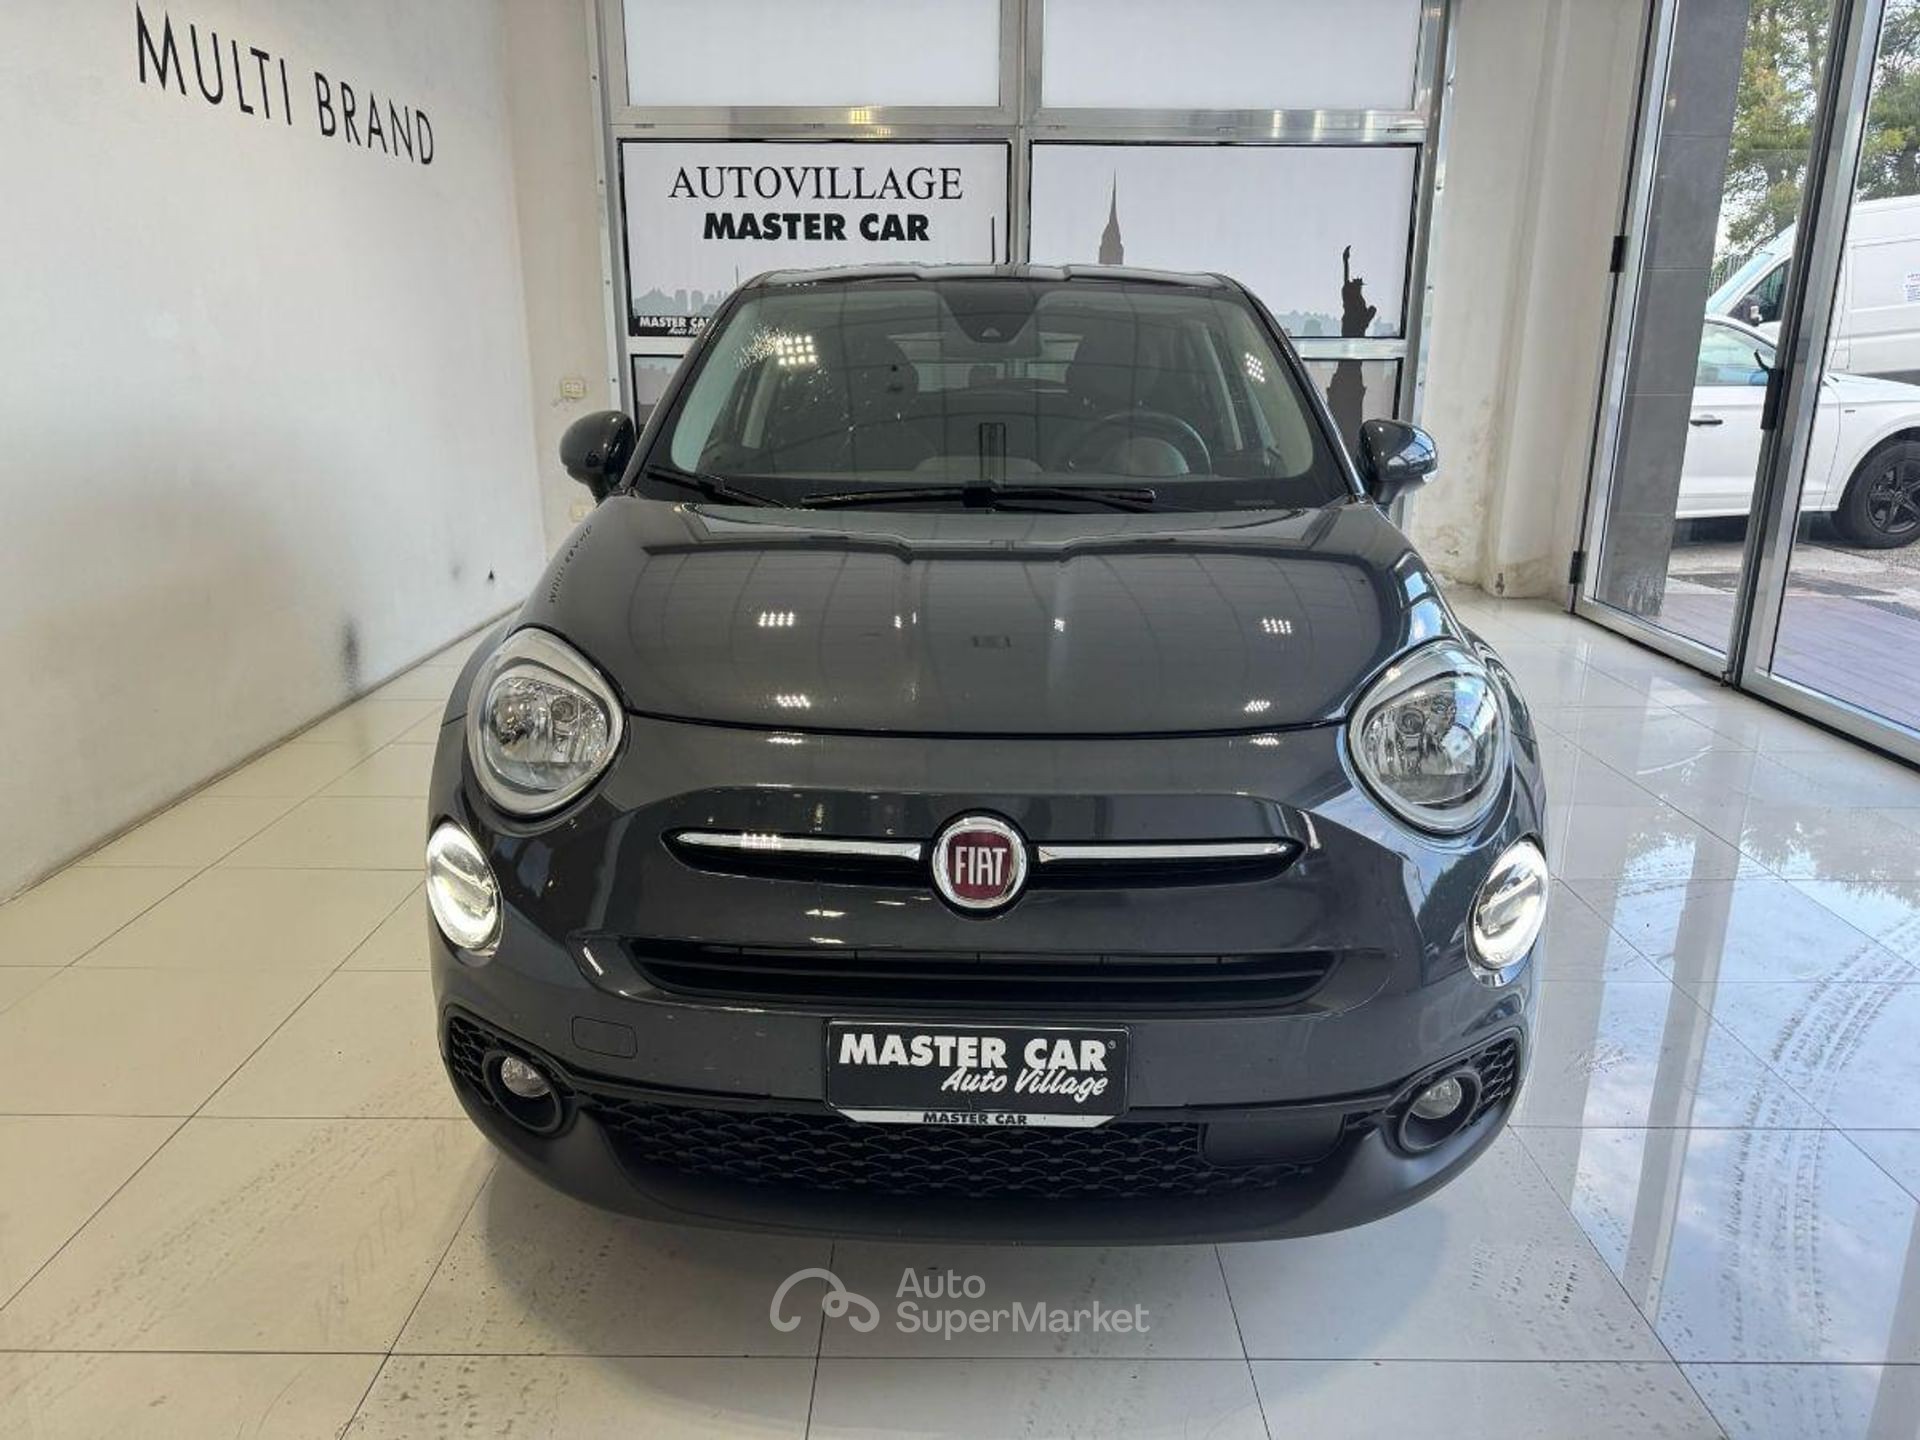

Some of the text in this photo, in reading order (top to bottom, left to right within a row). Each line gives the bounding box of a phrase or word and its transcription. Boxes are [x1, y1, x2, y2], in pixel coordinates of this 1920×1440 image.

[135, 1, 434, 165] MULTI BRAND
[668, 166, 964, 200] AUTOVILLAGE
[703, 212, 930, 242] MASTER CAR
[640, 316, 687, 328] MASTER
[955, 846, 1008, 886] FIAT
[838, 1033, 1107, 1072] MASTER CAR
[940, 1066, 1108, 1104] Auto Village
[922, 1111, 1028, 1126] MASTER CAR
